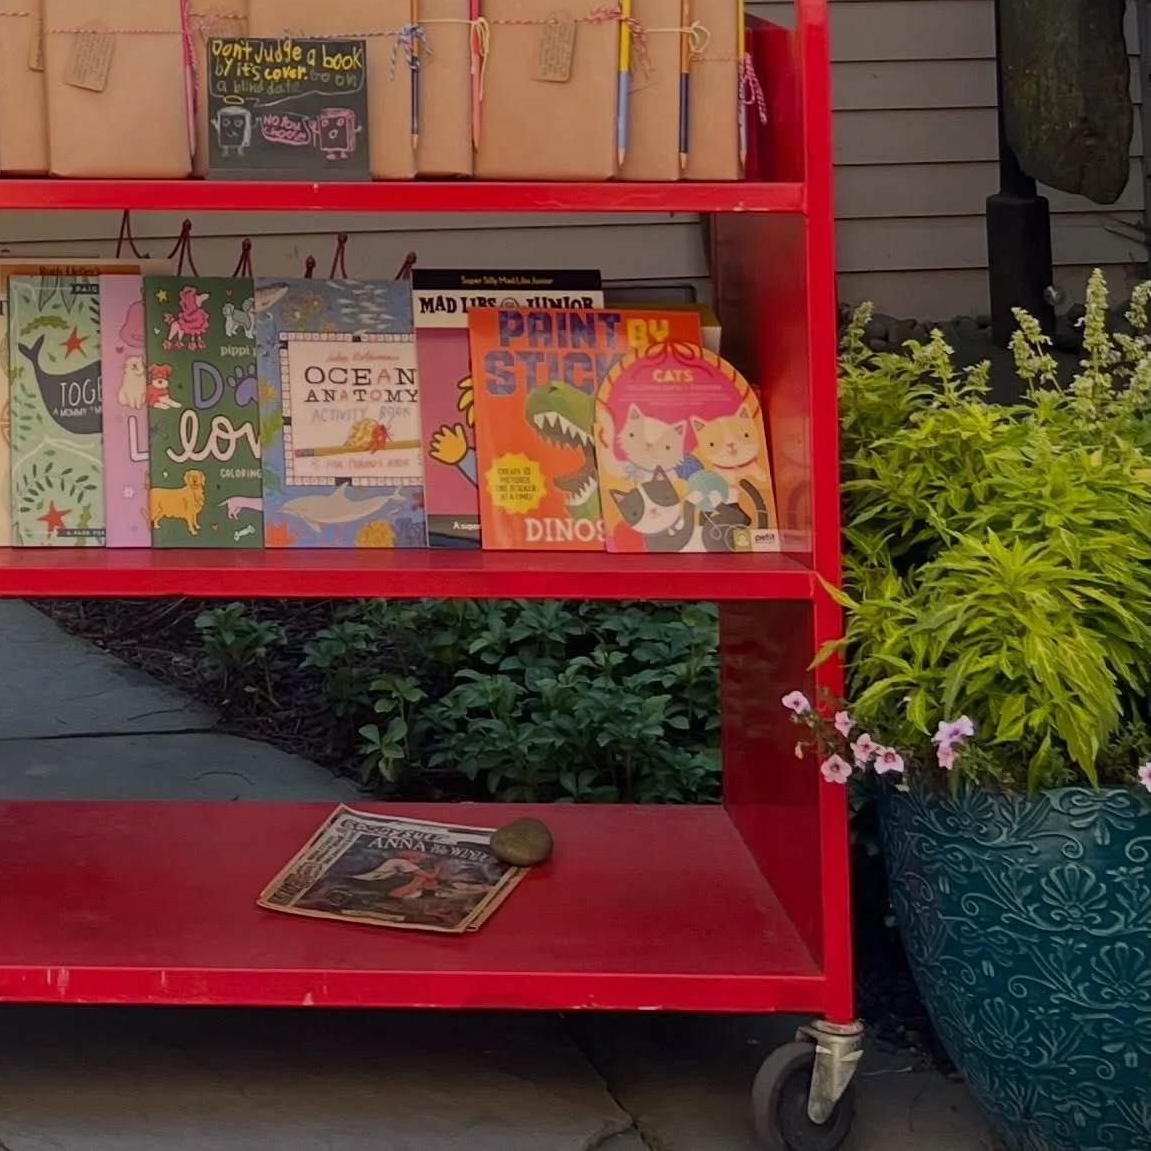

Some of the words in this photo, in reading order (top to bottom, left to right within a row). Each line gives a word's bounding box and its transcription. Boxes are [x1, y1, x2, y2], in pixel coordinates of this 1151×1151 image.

[212, 39, 252, 60] Don't
[306, 48, 316, 66] a
[335, 72, 357, 88] on
[419, 295, 457, 313] MAD
[461, 296, 497, 312] LIBS
[526, 296, 594, 309] JUNIOR
[498, 310, 621, 349] PAINT
[626, 318, 668, 349] BY
[220, 345, 249, 357] pippi
[304, 365, 417, 386] OCEAN
[653, 369, 693, 383] CATS
[304, 388, 419, 403] ANATOMY
[311, 407, 369, 423] ACTIVITY
[367, 838, 426, 852] ANNA
